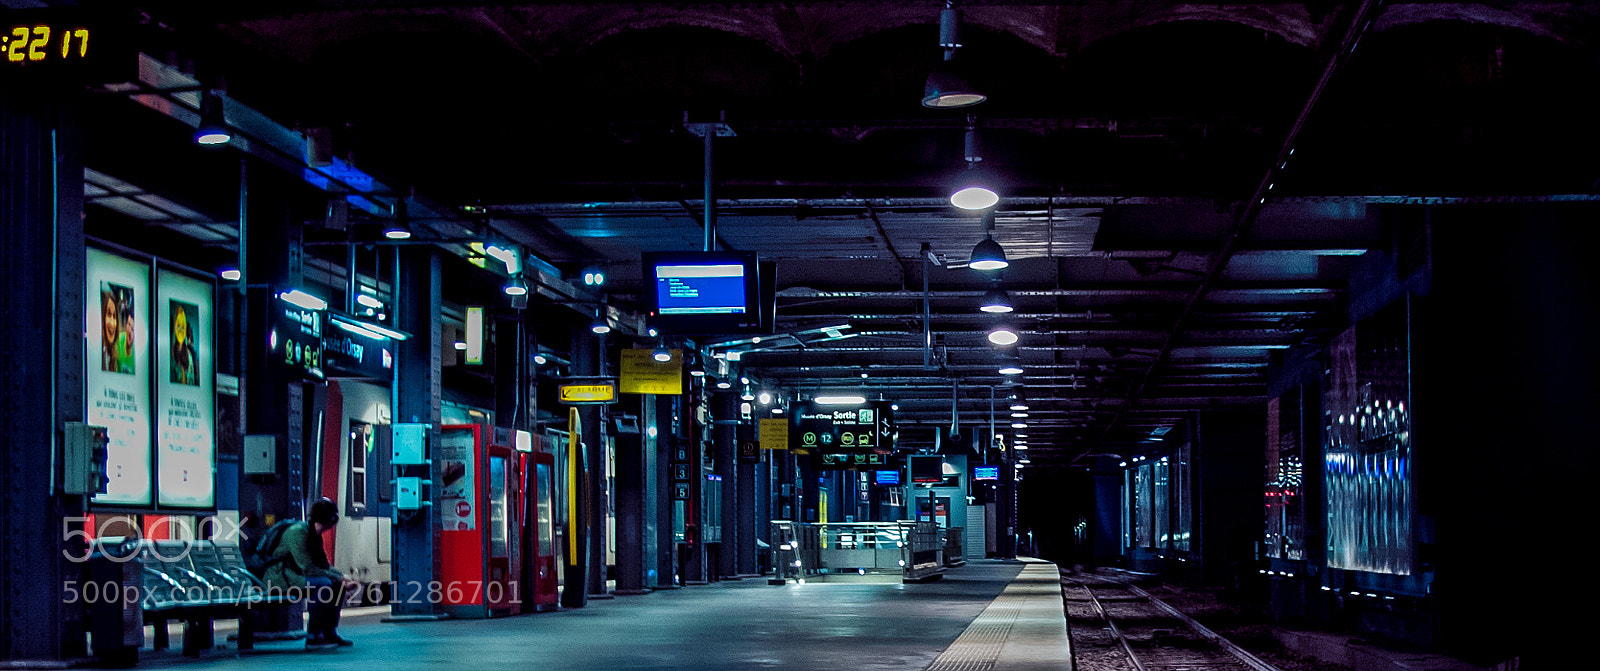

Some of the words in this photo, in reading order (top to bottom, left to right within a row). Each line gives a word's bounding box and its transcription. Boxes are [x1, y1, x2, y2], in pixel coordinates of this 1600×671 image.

[62, 29, 89, 59] 17
[833, 410, 856, 420] Sortie
[821, 434, 832, 442] 12
[679, 470, 686, 478] 3
[679, 488, 686, 498] 5
